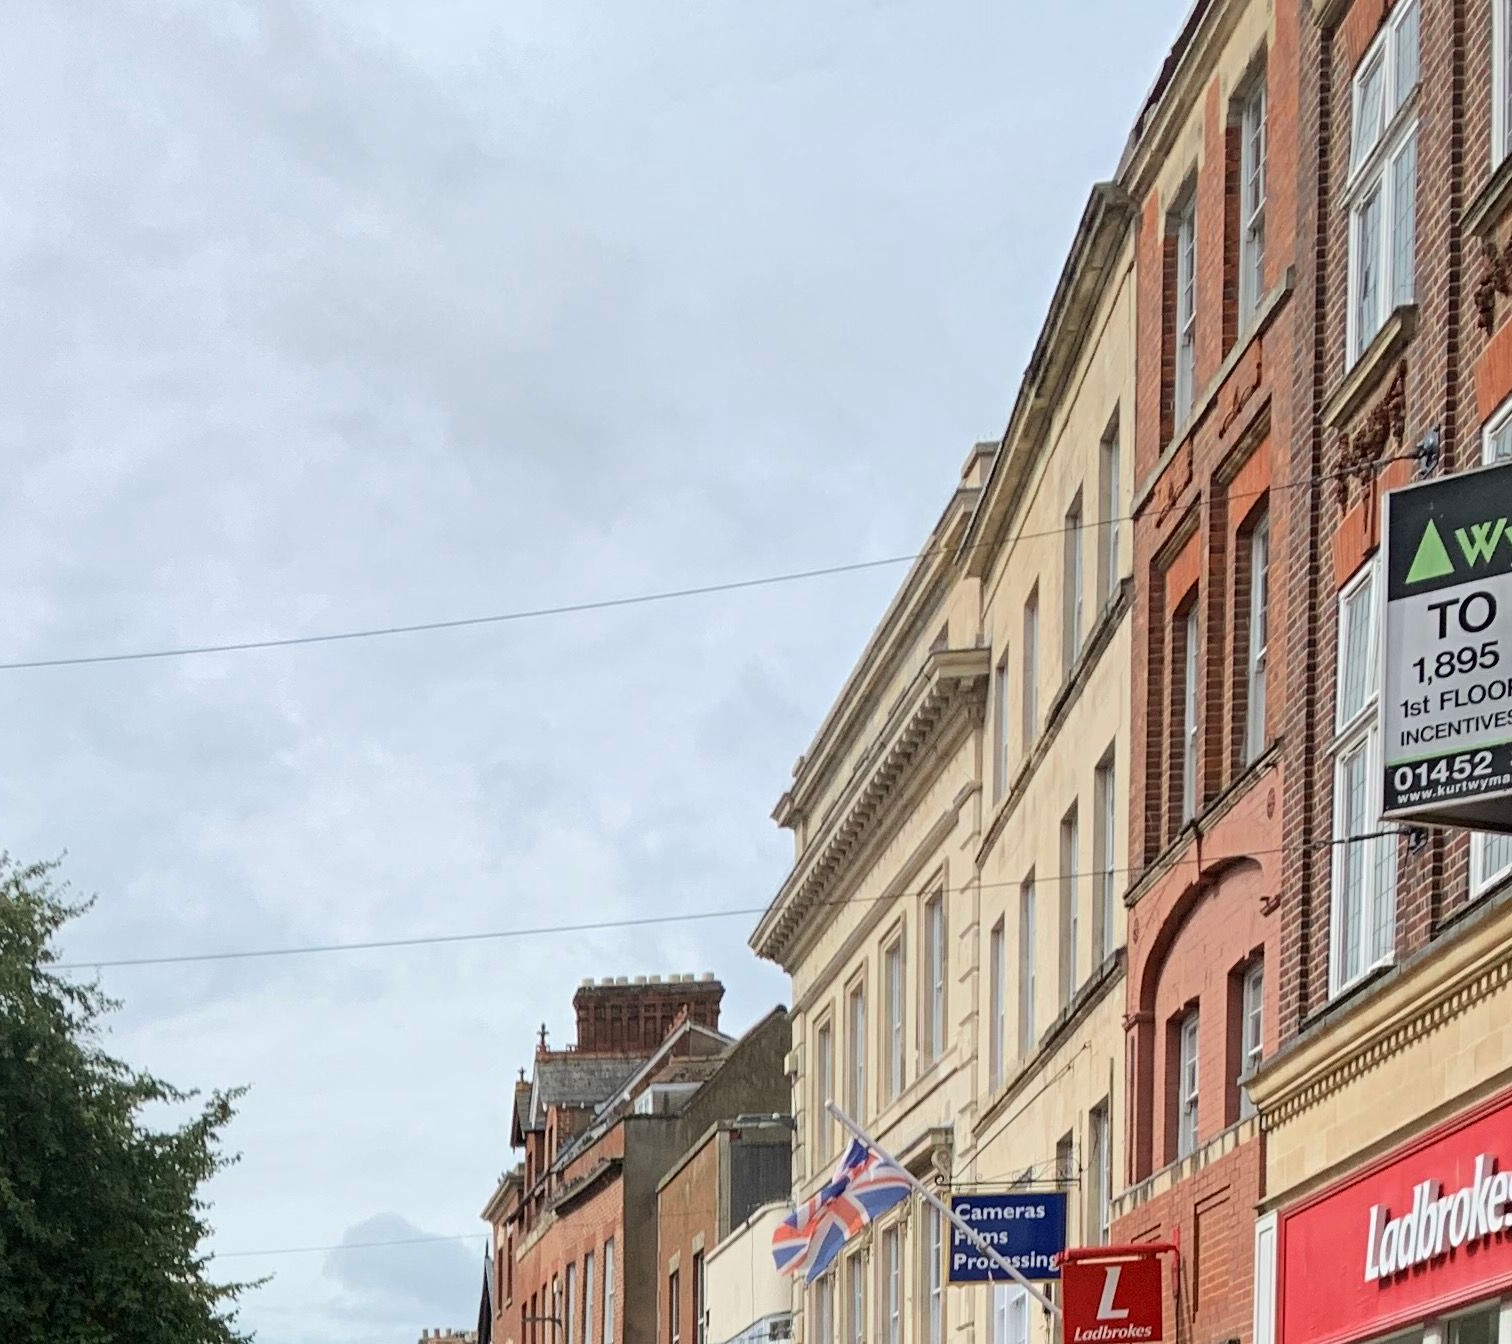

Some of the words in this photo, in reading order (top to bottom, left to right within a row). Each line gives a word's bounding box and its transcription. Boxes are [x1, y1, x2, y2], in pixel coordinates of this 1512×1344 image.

[1427, 590, 1497, 640] TO
[1412, 640, 1500, 686] 1,895
[1400, 695, 1431, 719] 1st
[1394, 749, 1493, 792] 01452
[1397, 773, 1512, 804] www.kurtwyma
[955, 1203, 1046, 1222] Cameras
[954, 1228, 1008, 1247] Films
[1073, 1325, 1153, 1342] Ladbrokes
